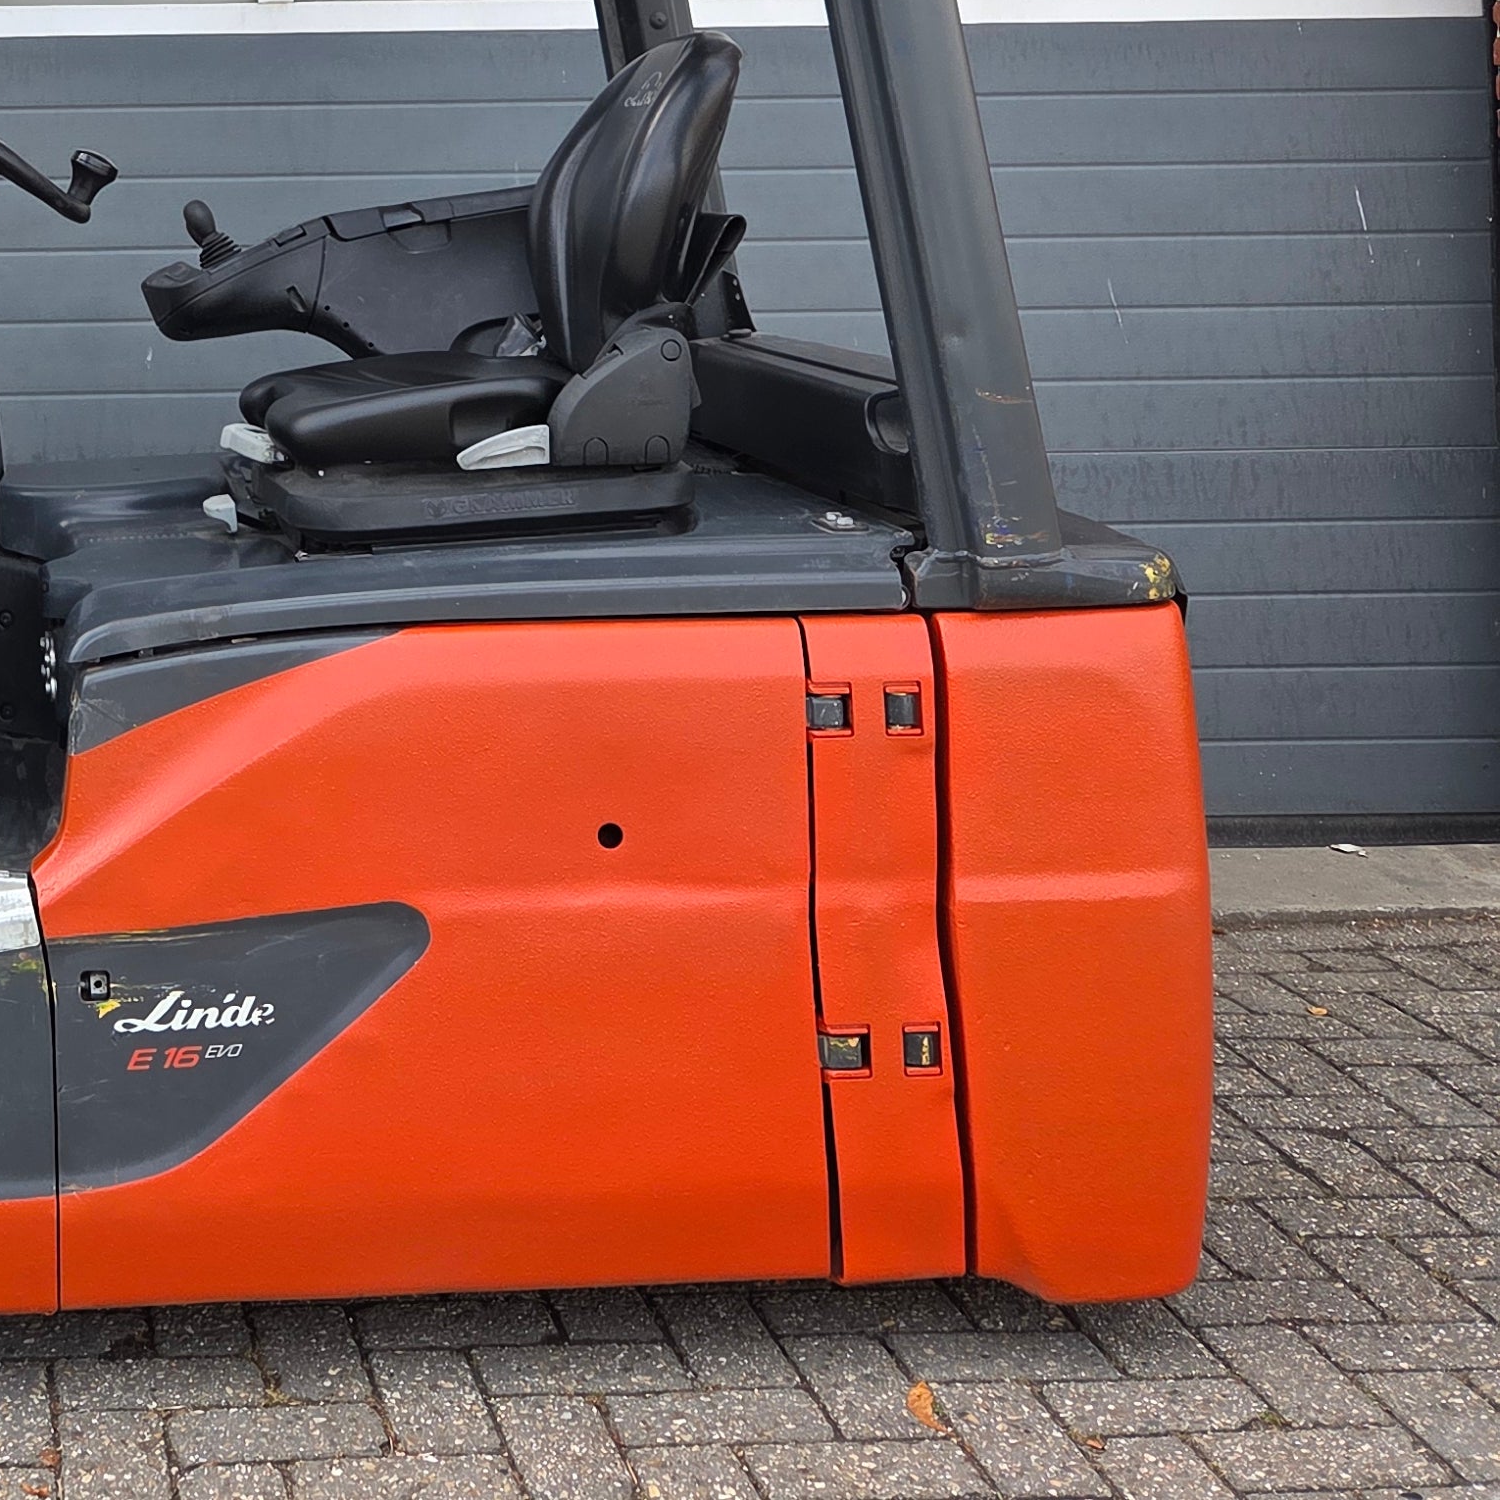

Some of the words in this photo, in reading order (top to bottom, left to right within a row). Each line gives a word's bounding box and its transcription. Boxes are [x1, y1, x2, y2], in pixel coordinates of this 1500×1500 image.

[113, 990, 275, 1033] Linde
[127, 1048, 157, 1071] E
[163, 1046, 202, 1069] 16
[204, 1043, 243, 1059] EVO
